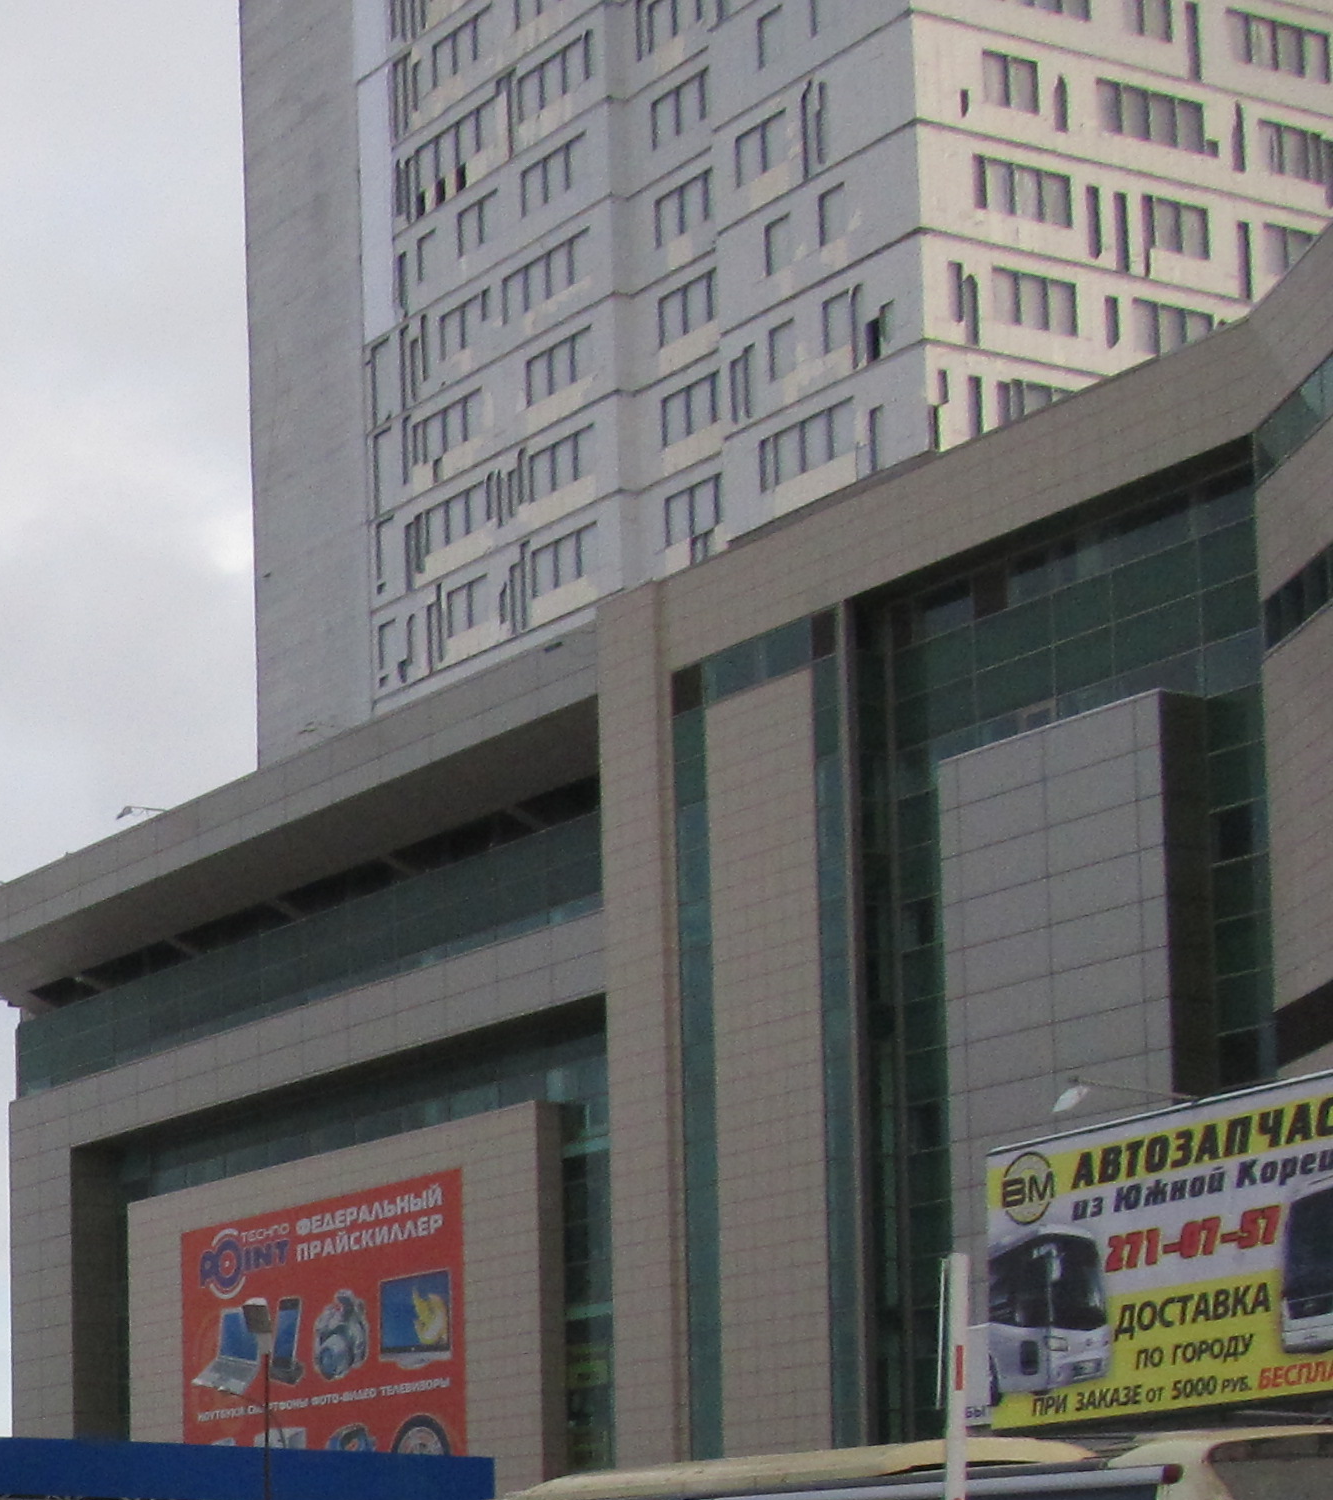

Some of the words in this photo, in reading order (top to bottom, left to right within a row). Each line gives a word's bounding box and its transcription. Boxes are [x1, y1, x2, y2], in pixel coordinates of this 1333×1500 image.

[295, 1183, 443, 1236] ФЕДЕРАЛЬНЫЙ
[1072, 1195, 1104, 1221] из
[1114, 1167, 1226, 1212] Южной
[199, 1238, 290, 1290] POINT
[296, 1214, 443, 1262] ПРАЙСКИЛЛЕР
[1105, 1204, 1281, 1273] 271-07-57
[1113, 1282, 1272, 1342] ДОСТАВКА
[1135, 1348, 1165, 1370] ПО
[1172, 1333, 1255, 1365] ГОРОДУ
[247, 1397, 309, 1414] СМРТФОНЫ
[380, 1377, 450, 1396] ТЕЛЕВИЗОРЫ
[1032, 1393, 1068, 1416] ПРИ
[1075, 1384, 1142, 1411] ЗАКАЗЕ
[1171, 1375, 1217, 1400] 5000
